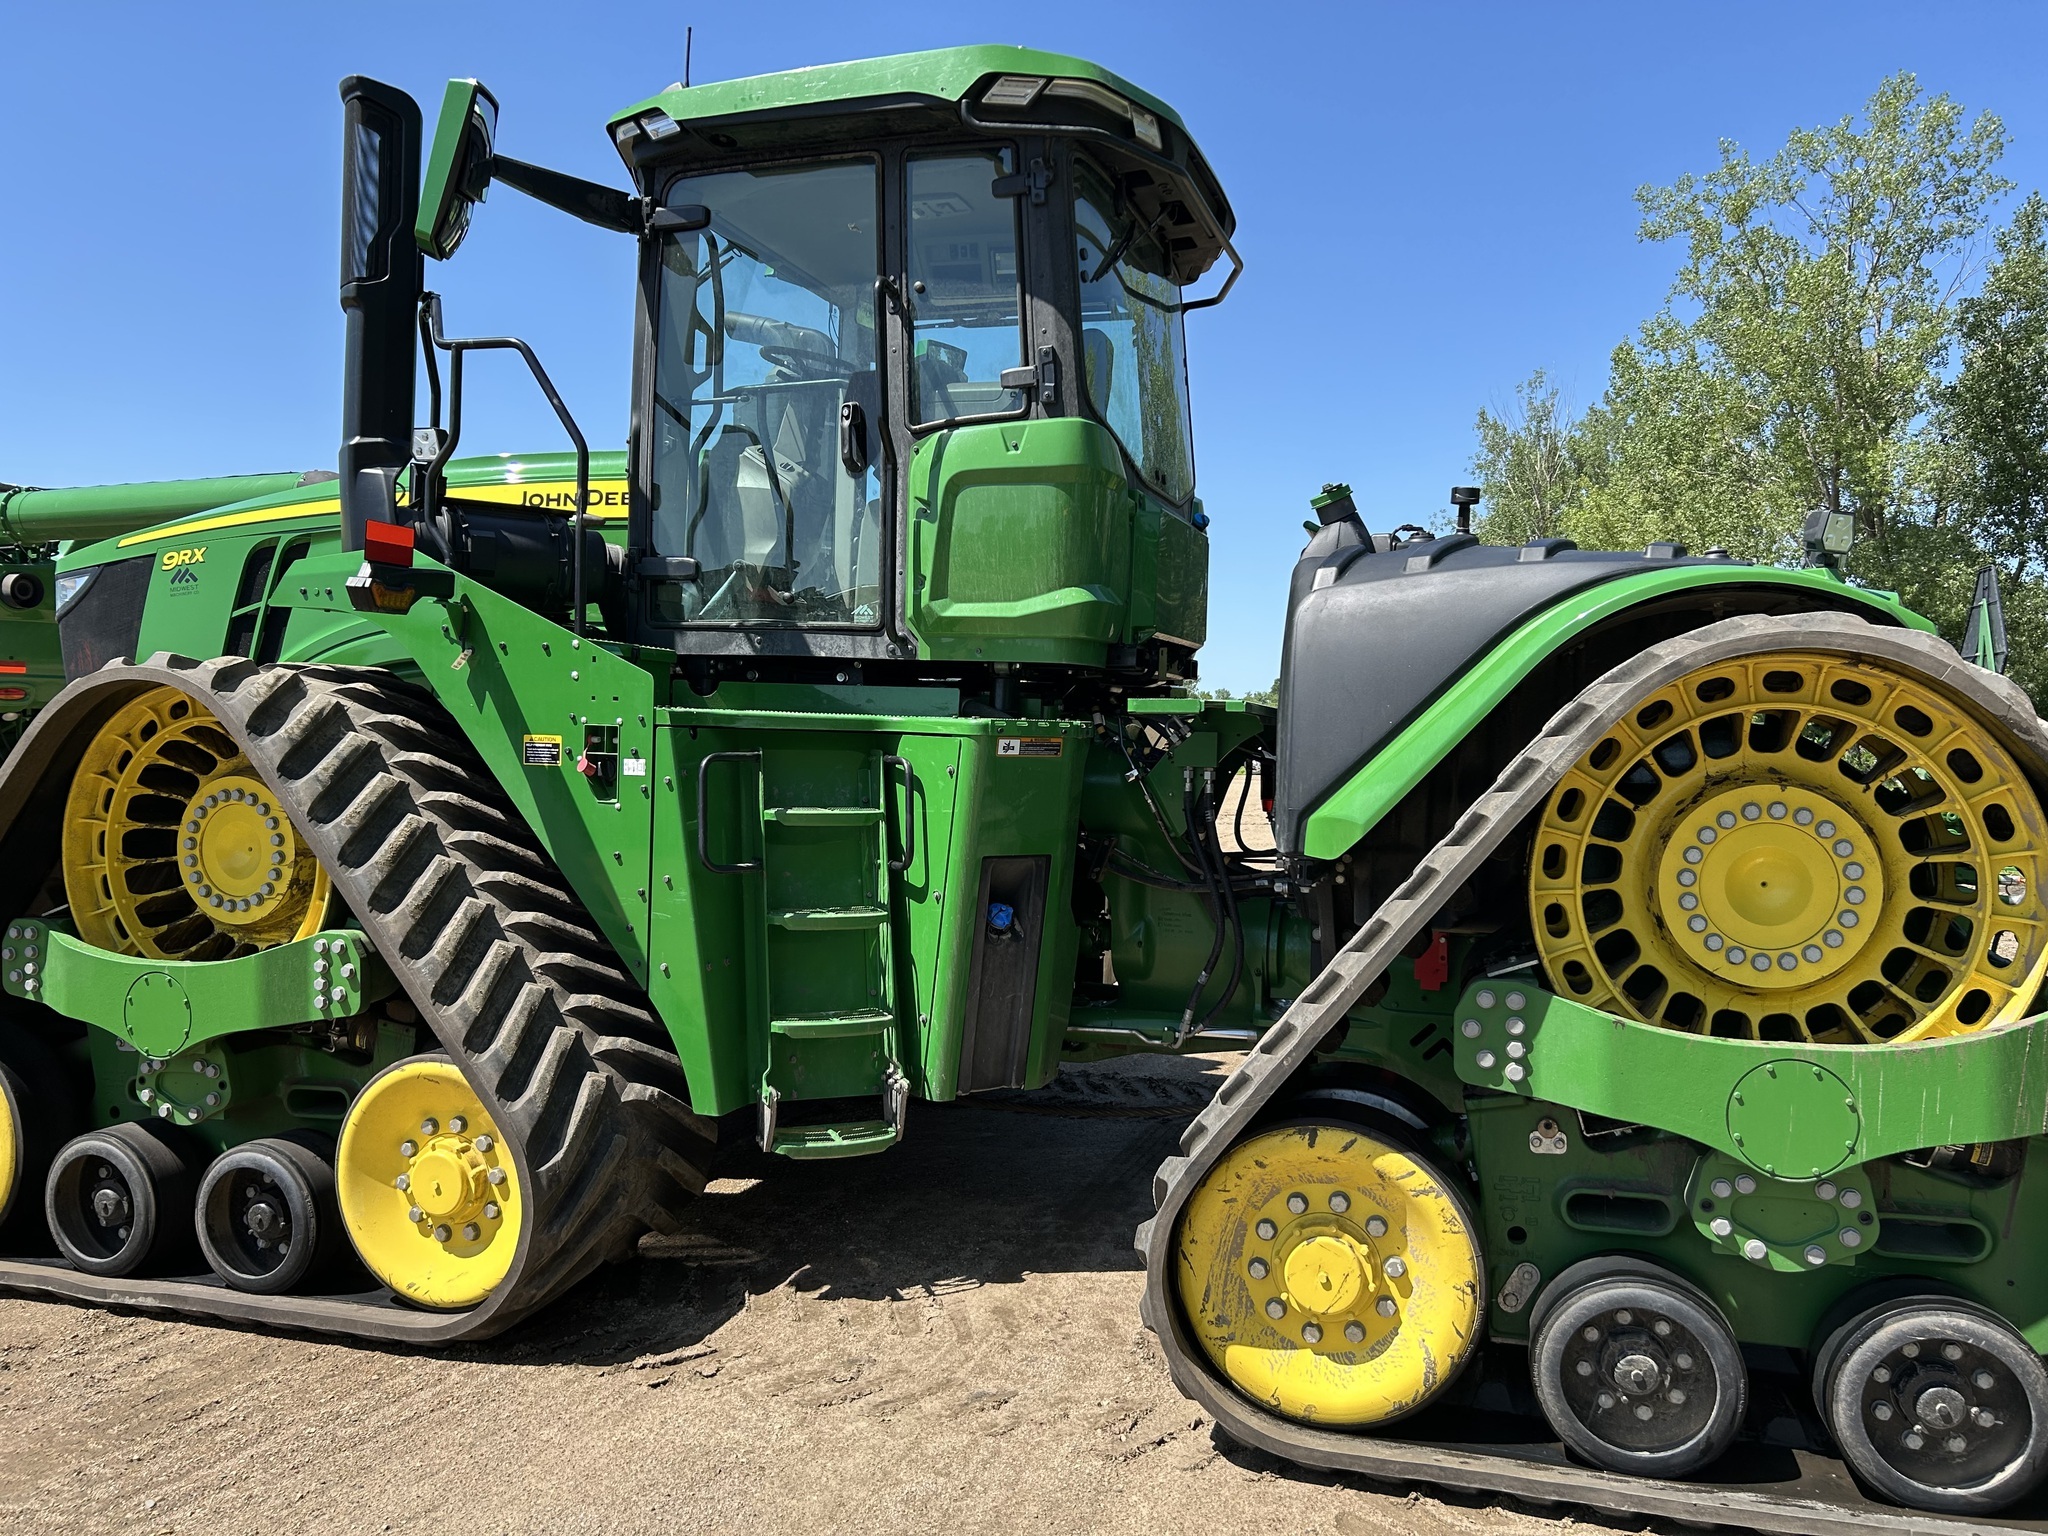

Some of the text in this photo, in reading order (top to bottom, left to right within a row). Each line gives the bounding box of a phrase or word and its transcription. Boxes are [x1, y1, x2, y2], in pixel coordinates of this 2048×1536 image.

[521, 491, 577, 507] JOHN
[161, 546, 208, 571] 9RX
[170, 584, 199, 592] MIDWEST
